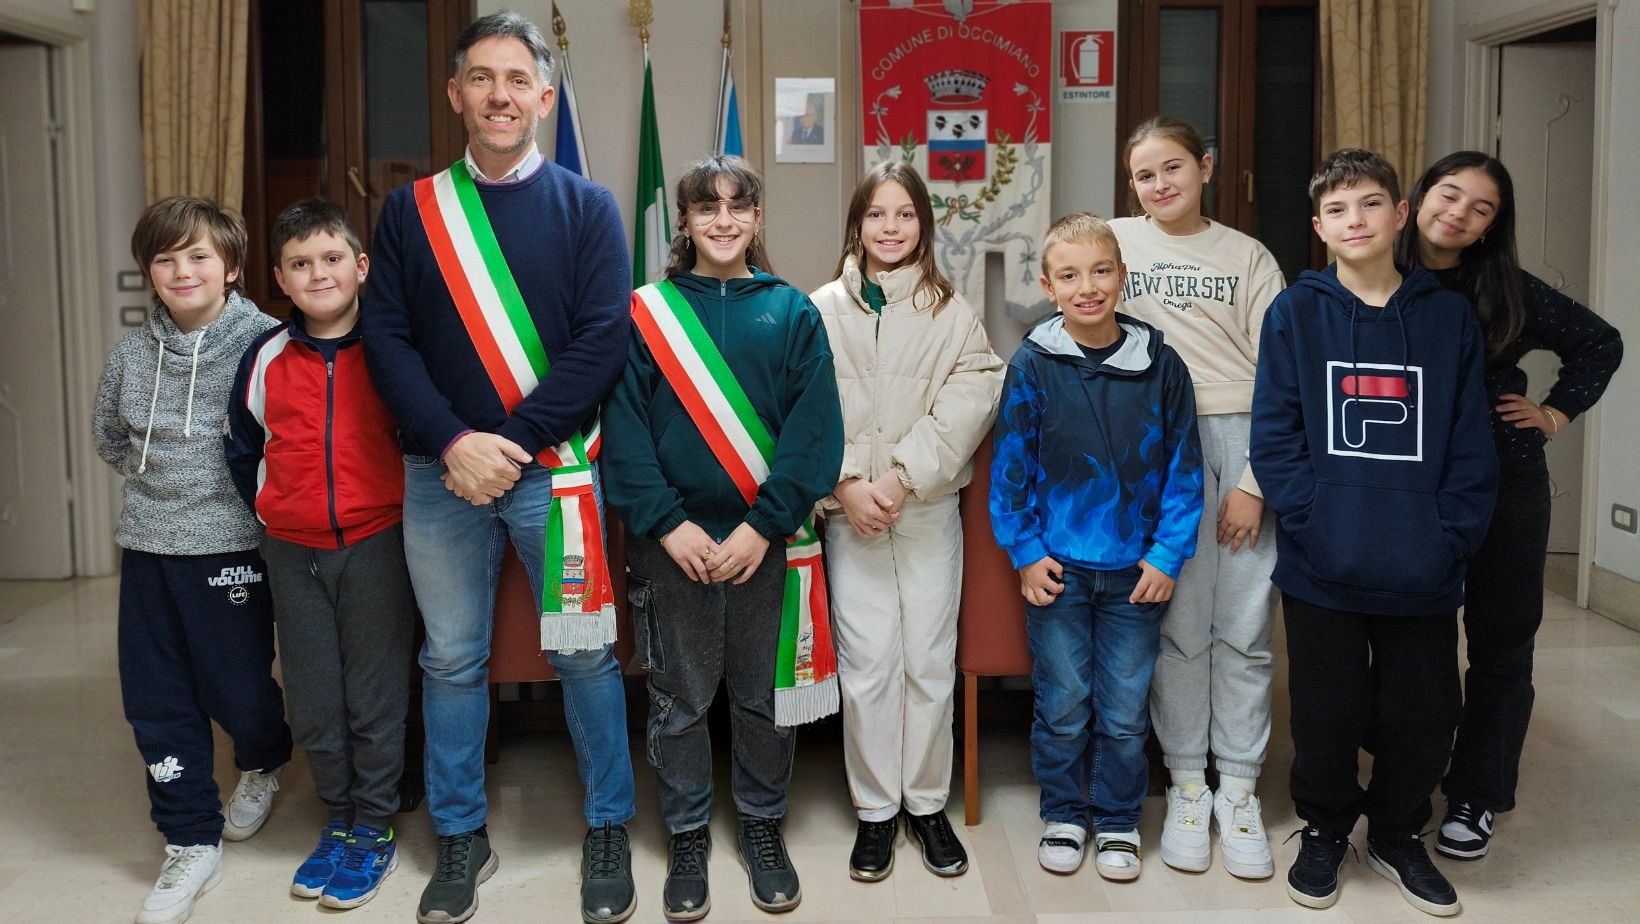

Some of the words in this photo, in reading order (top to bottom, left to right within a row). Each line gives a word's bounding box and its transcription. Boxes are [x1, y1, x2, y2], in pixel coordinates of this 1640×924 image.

[871, 28, 933, 81] COMUNE
[937, 25, 953, 40] DI
[958, 24, 1040, 78] OCCIMIANO
[1062, 90, 1111, 99] ESTINTORE
[1164, 275, 1240, 306] JERSEY
[1163, 298, 1192, 311] Omega
[220, 565, 254, 578] FULL
[207, 572, 263, 587] VOLUME
